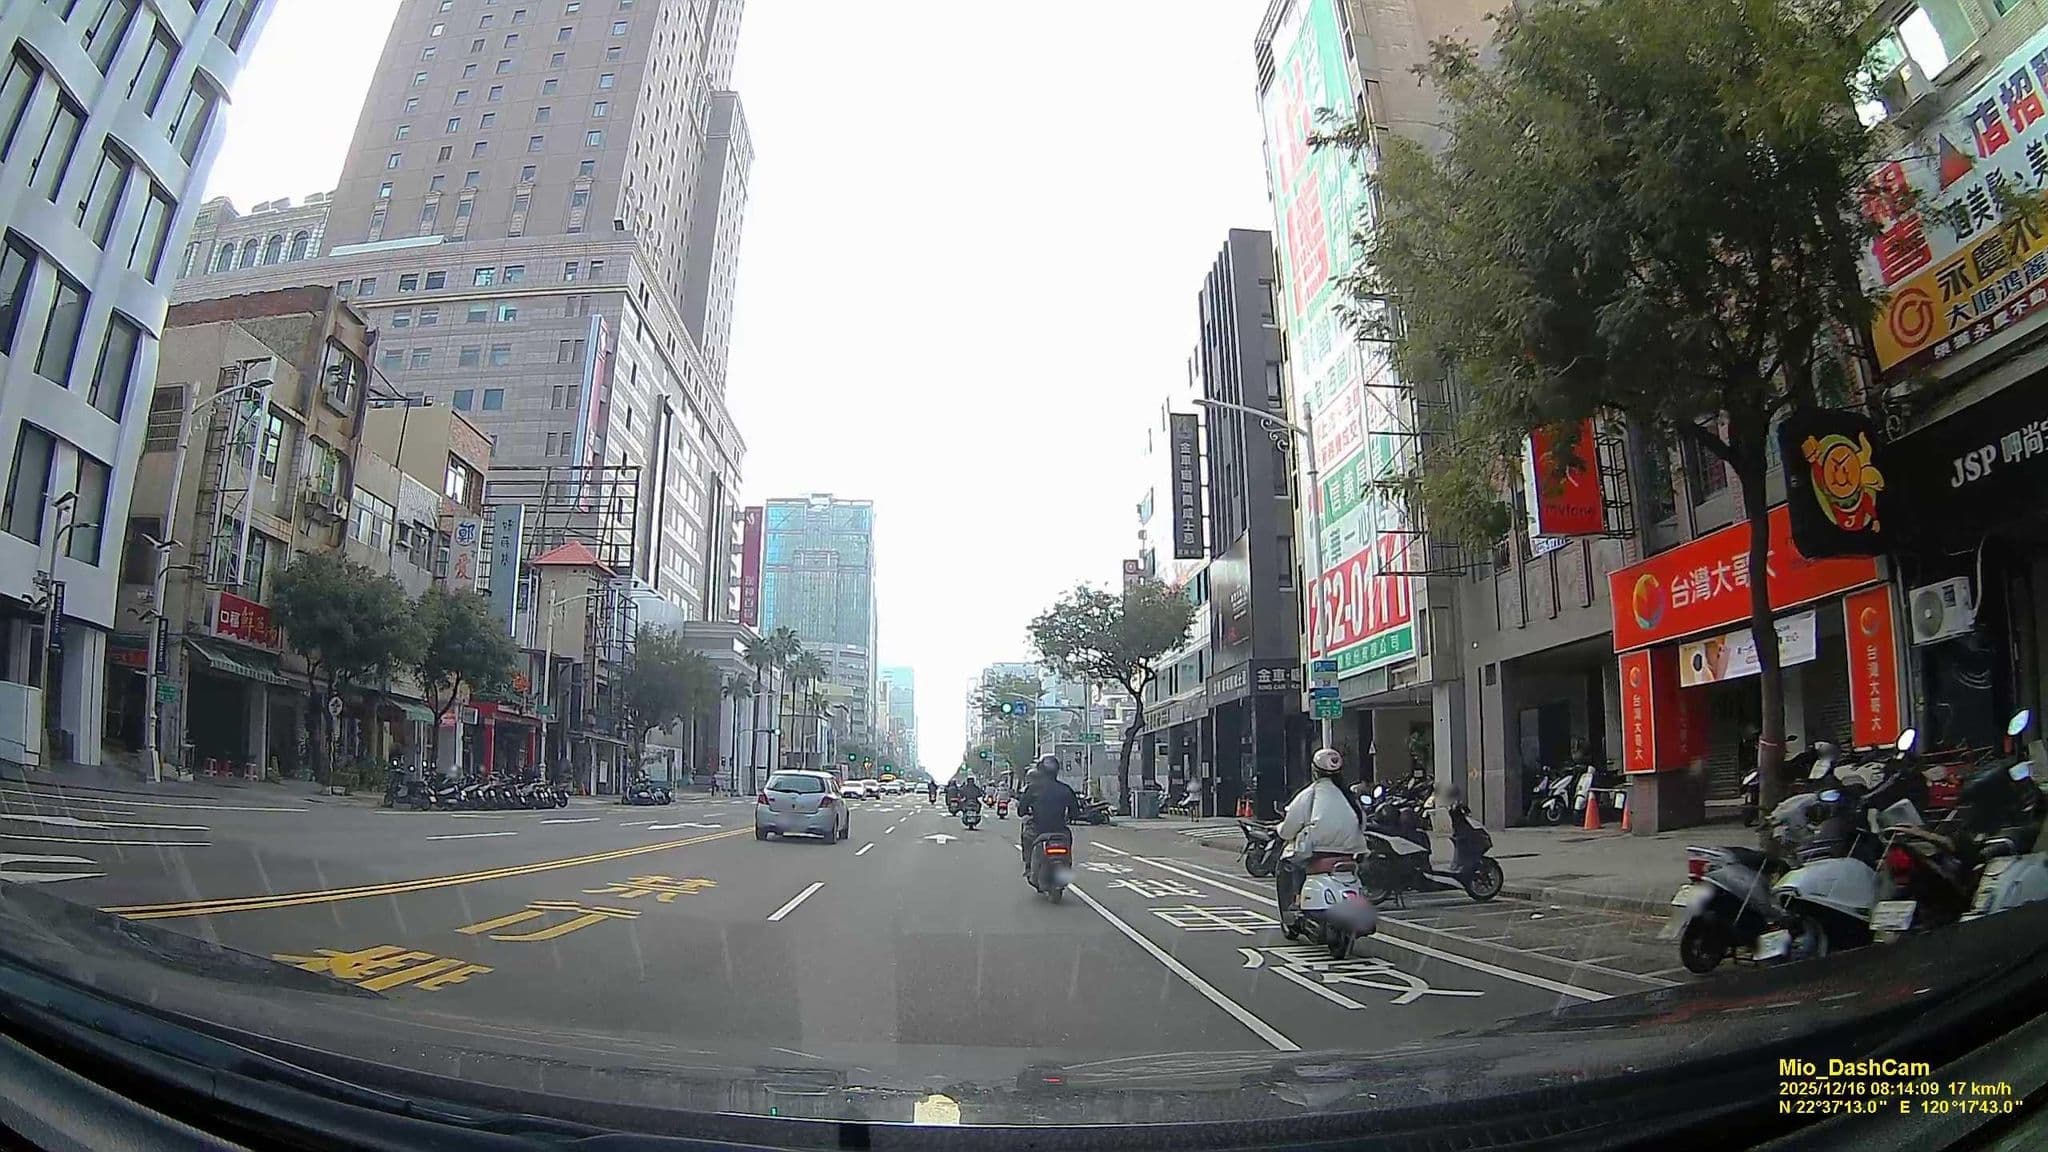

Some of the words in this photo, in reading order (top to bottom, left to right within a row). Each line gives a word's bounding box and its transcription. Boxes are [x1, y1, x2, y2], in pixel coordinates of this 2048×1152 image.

[1935, 199, 2048, 303] 永慶不
[1951, 445, 1997, 488] JSP
